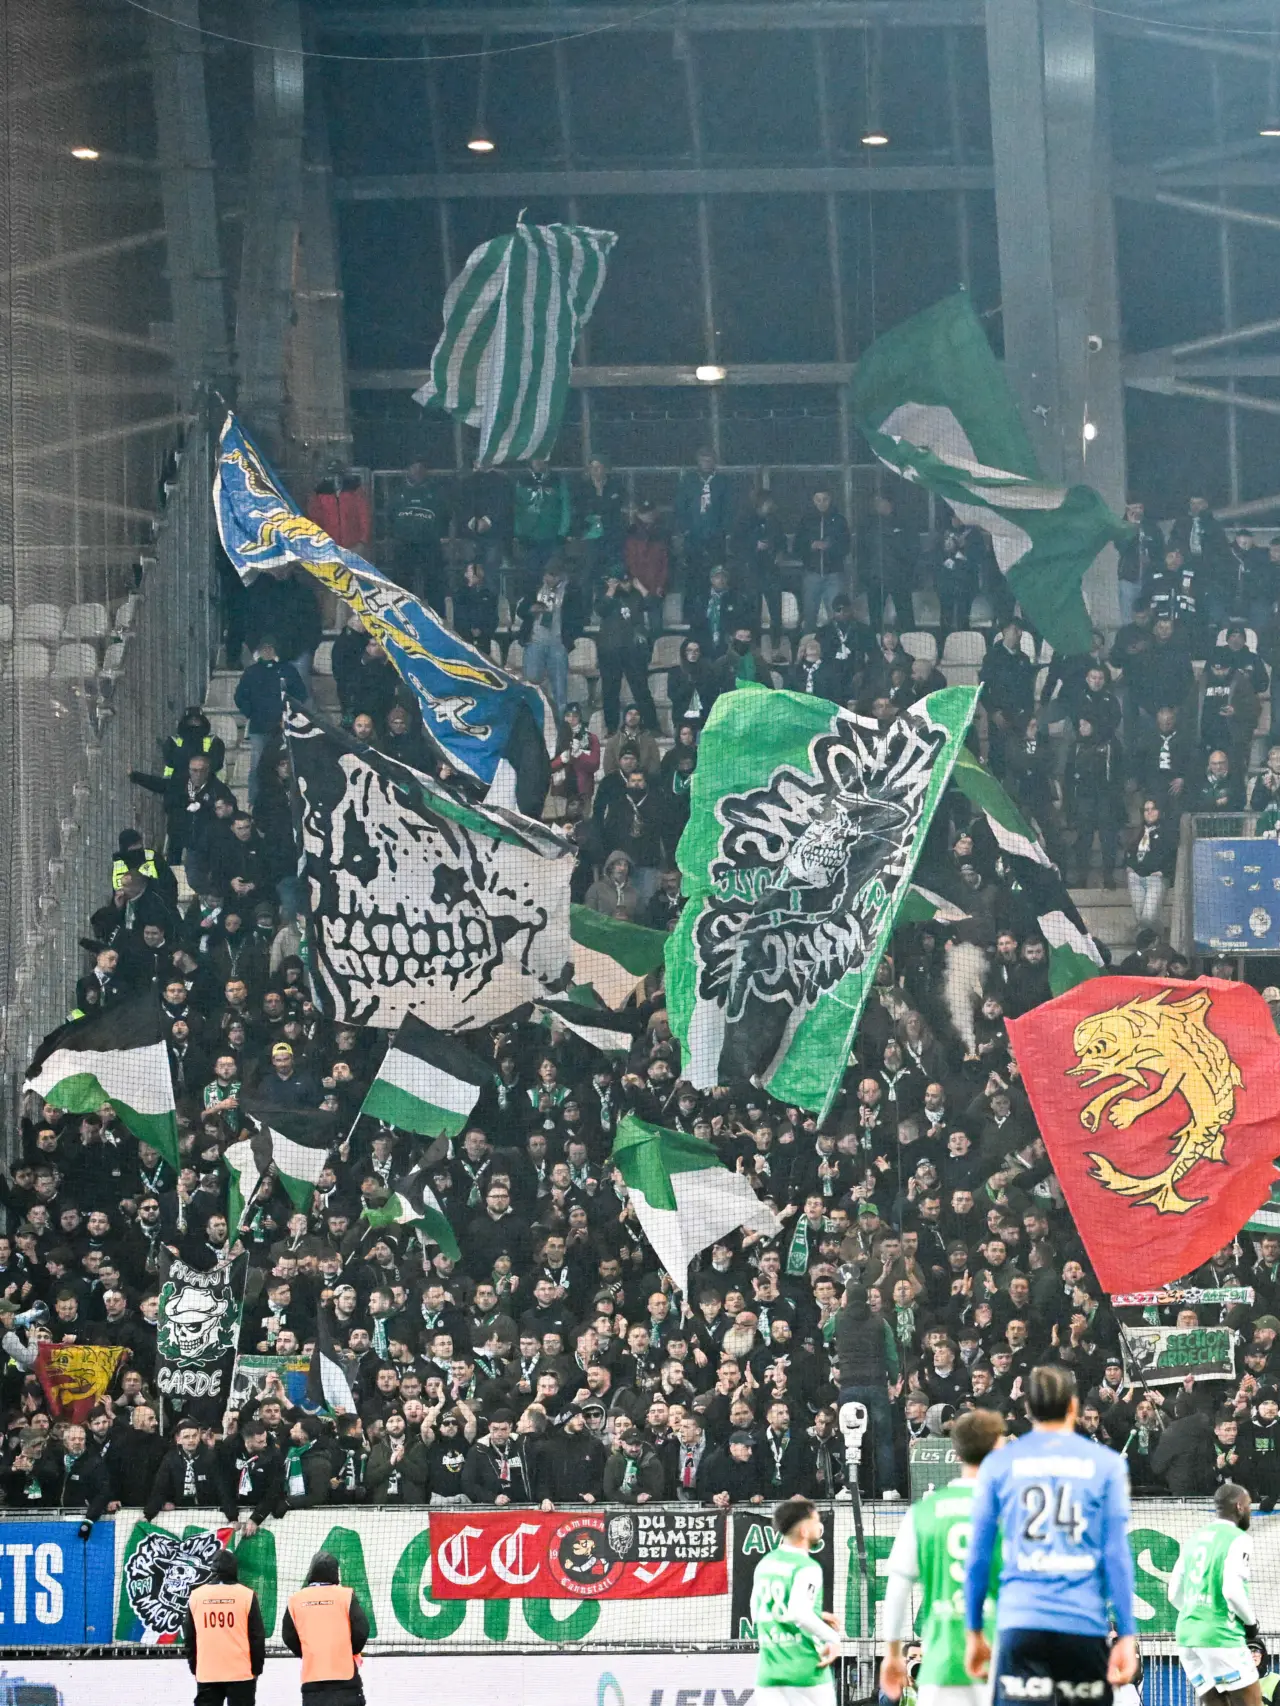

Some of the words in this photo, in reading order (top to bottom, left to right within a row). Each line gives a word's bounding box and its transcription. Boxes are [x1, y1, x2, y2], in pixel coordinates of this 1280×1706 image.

[169, 1259, 231, 1288] AVANT
[1166, 1329, 1230, 1350] SECTION
[157, 1366, 223, 1398] GARDE
[638, 1515, 665, 1529] DU
[675, 1514, 718, 1529] BIST
[1021, 1482, 1088, 1544] 24
[638, 1529, 718, 1546] IMMER
[637, 1546, 668, 1558] BEI
[675, 1545, 719, 1559] UNS!
[0, 1542, 63, 1624] TS
[136, 1594, 181, 1631] MAGIC
[204, 1611, 235, 1629] 1090
